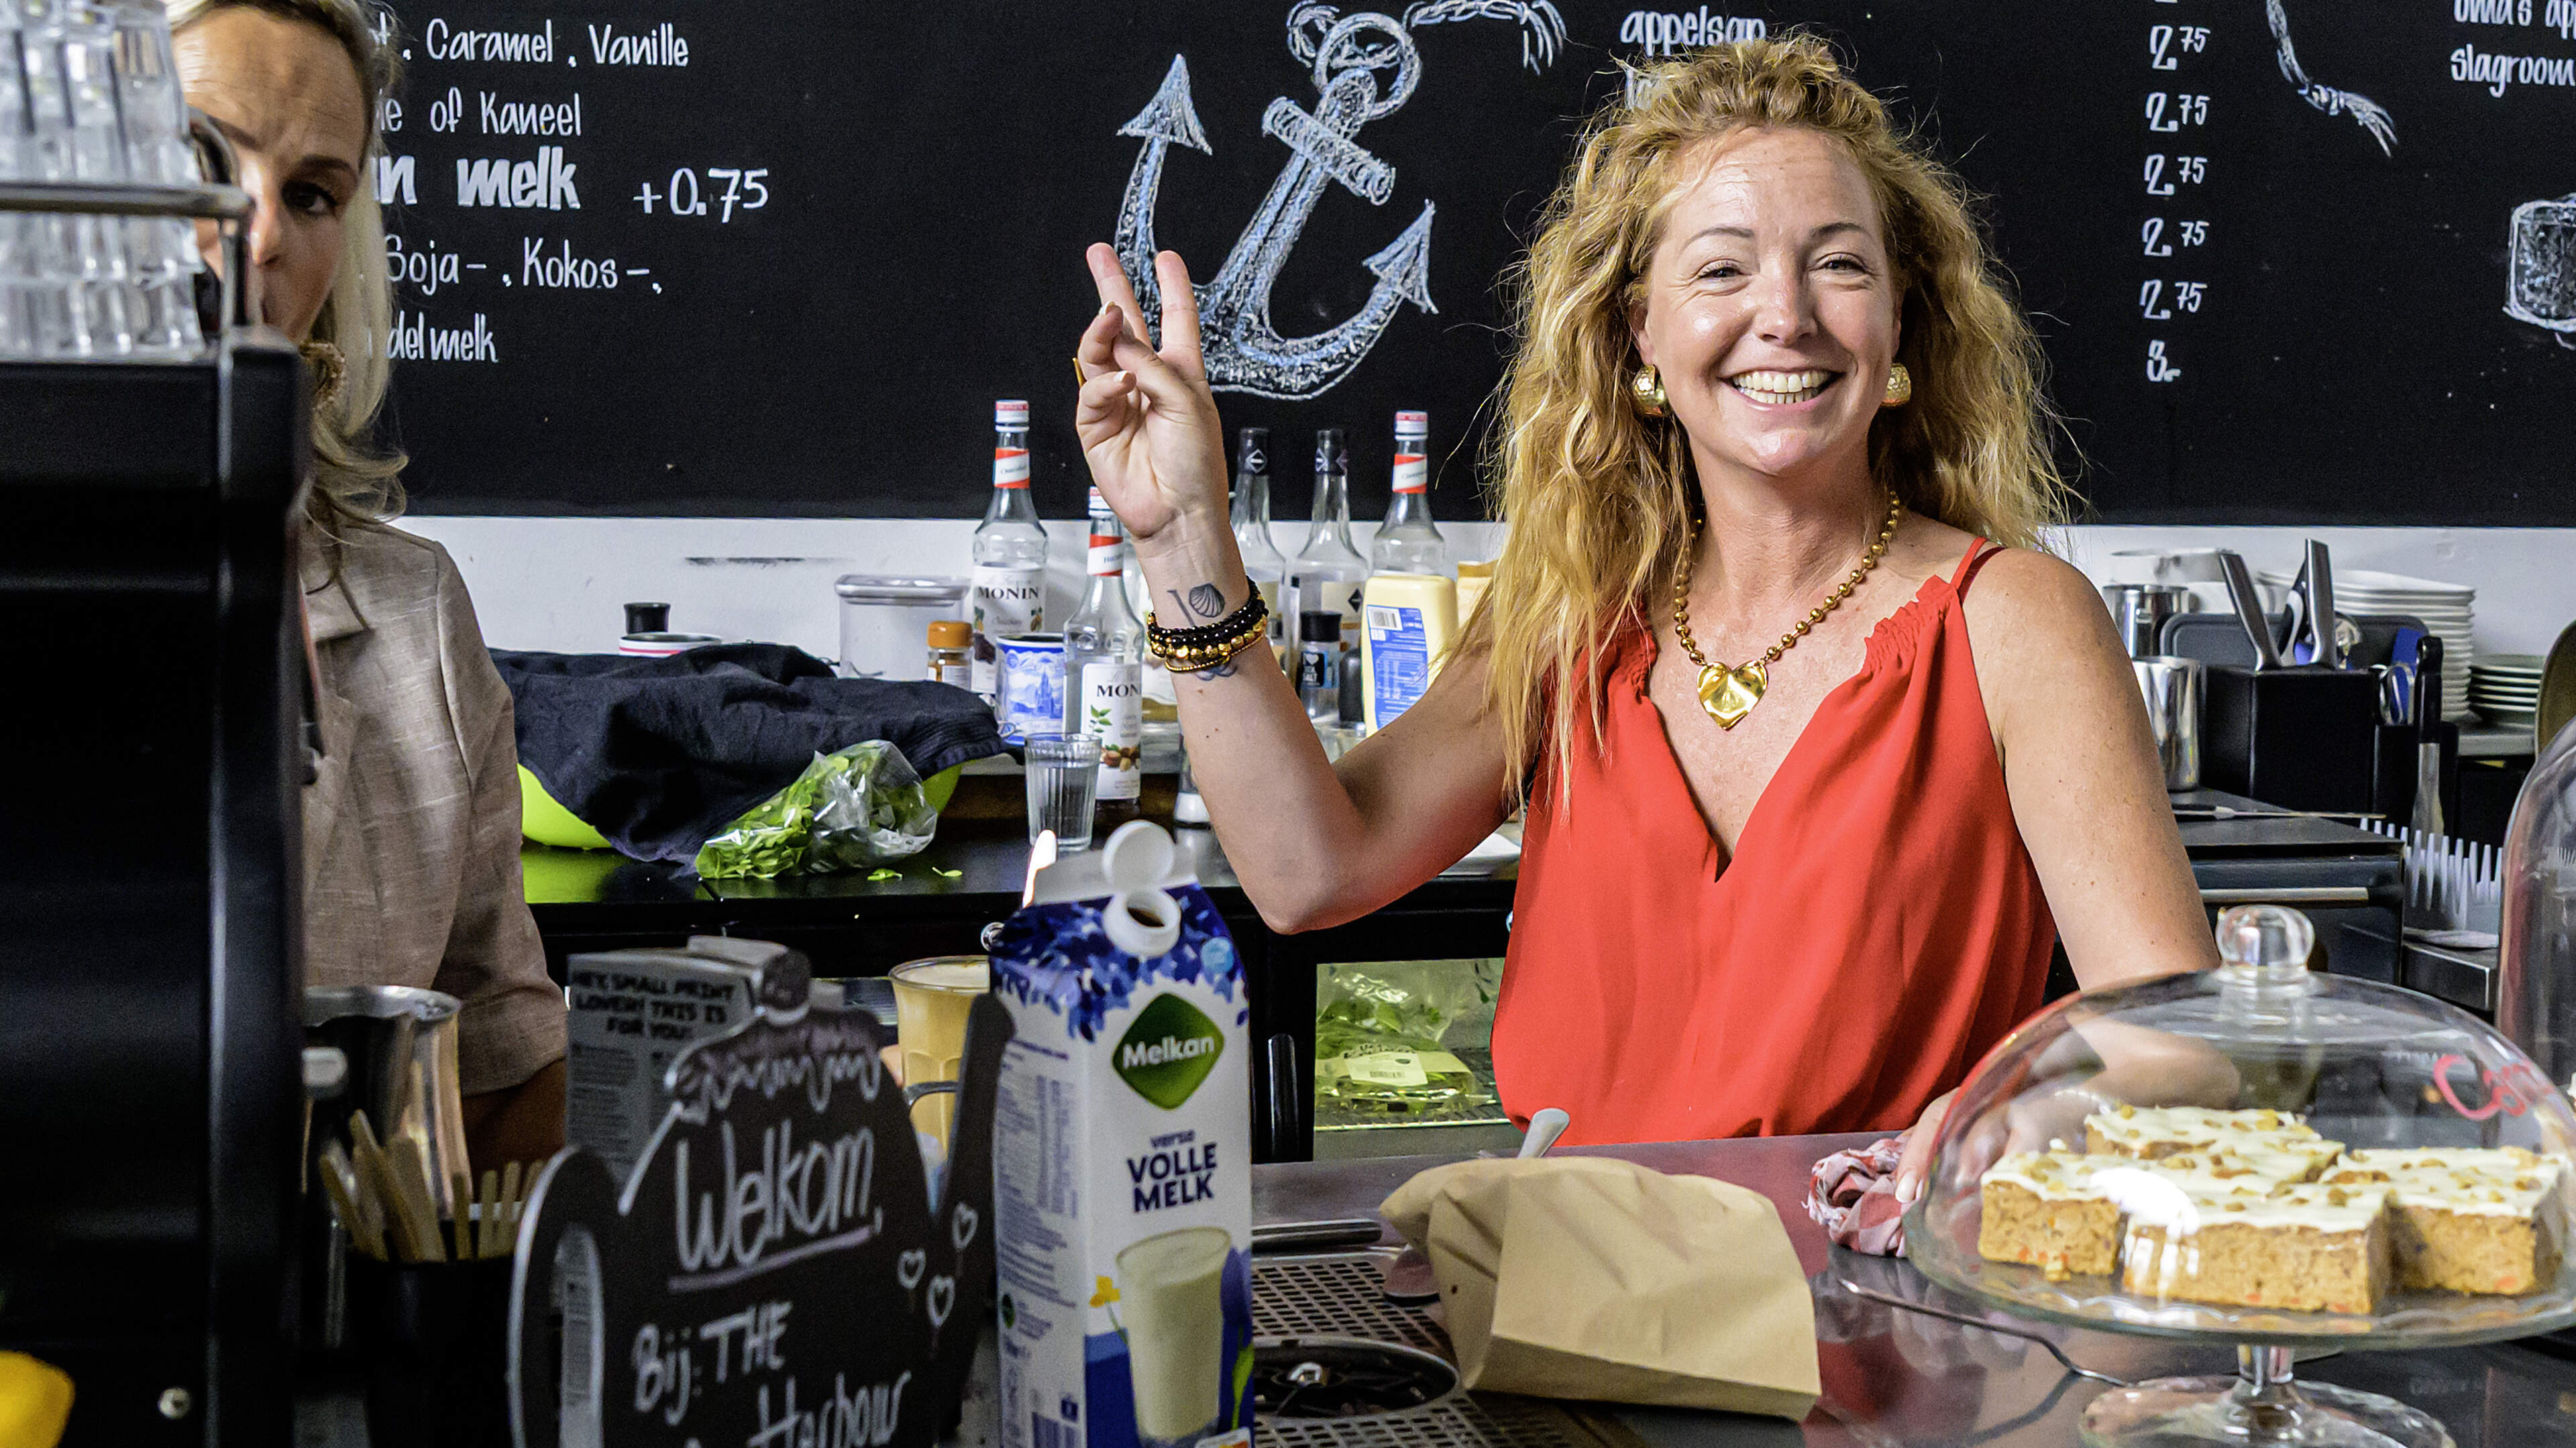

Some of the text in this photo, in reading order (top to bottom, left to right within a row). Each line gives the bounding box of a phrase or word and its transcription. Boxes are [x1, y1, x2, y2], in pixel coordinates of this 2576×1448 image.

[588, 23, 689, 66] Vanille
[1621, 5, 1766, 56] appelsap
[2451, 44, 2576, 98] slagroom
[430, 87, 462, 132] of
[480, 91, 582, 136] Kaneel
[456, 146, 581, 210] melk
[978, 586, 1039, 600] MONIN
[1097, 683, 1140, 698] MON
[610, 974, 667, 994] SMALL
[674, 979, 736, 1000] PRINT
[606, 1016, 645, 1034] FOR
[649, 1001, 698, 1021] THIS
[706, 1005, 728, 1023] IS
[1123, 1036, 1215, 1069] Melkan
[1127, 1141, 1217, 1184] VOLLE
[1132, 1173, 1214, 1213] MELK
